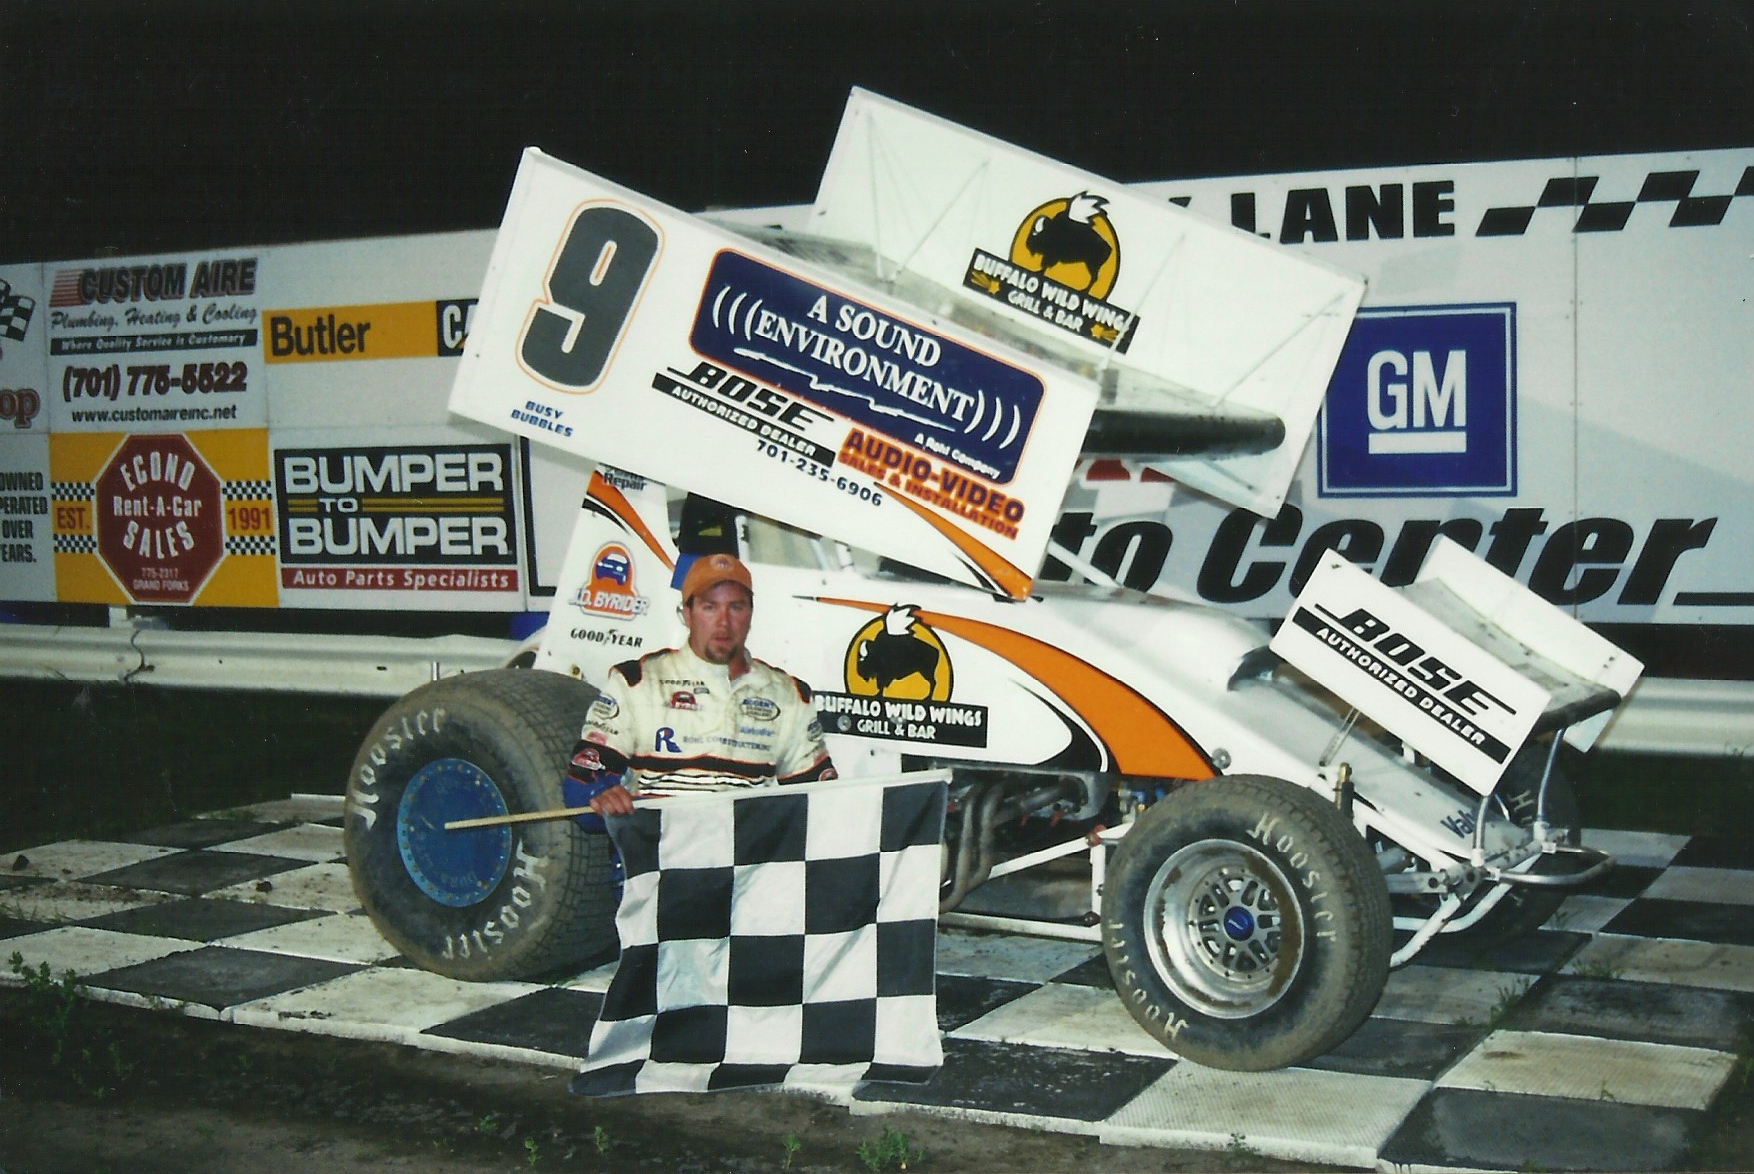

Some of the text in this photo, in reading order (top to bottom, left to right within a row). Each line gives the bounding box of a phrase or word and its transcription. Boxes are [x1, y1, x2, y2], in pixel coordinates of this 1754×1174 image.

[1230, 180, 1455, 244] LANE
[79, 257, 258, 304] CUSTOM AIRE
[520, 203, 662, 391] 9
[973, 254, 1130, 330] BUFFALO WILD WING
[51, 302, 258, 333] Plumbing, Heating & Cooling
[1007, 290, 1084, 332] GRILL & BAR
[96, 337, 131, 352] Quality
[136, 335, 172, 348] Service
[270, 314, 371, 357] Butler
[807, 295, 942, 368] A SOUND
[63, 364, 121, 402] (701)
[667, 361, 834, 431] BOSE
[1367, 349, 1467, 431] GM
[510, 409, 574, 437] BUBBLES
[524, 400, 564, 419] BUSY
[671, 385, 817, 457] AUTHORIZED DEALER
[119, 451, 196, 491] ECONO
[283, 453, 504, 494] BUMPER
[604, 472, 647, 491] Repair
[757, 439, 882, 507] 701-235-6906
[843, 427, 1025, 525] AUDIO-VIDEO
[951, 449, 1000, 479] Company
[113, 496, 202, 517] Rent-A-Car
[317, 497, 359, 513] TO
[838, 450, 1019, 540] SALES & INSTALLATION
[2, 519, 33, 539] OVER
[56, 507, 90, 530] EST.
[227, 507, 271, 530] 1991
[288, 517, 509, 555] BUMPER
[122, 520, 195, 559] SALES
[1197, 505, 1720, 606] Center
[133, 580, 189, 591] GRAND FORKS
[293, 570, 509, 590] Auto Parts Specialists
[594, 591, 651, 616] BYRIDER
[1314, 603, 1517, 716] BOSE
[1316, 627, 1487, 746] AUTHORIZED DEALER
[814, 694, 982, 727] BUFFALO WILD WINGS
[857, 719, 936, 739] GRILL & BAR
